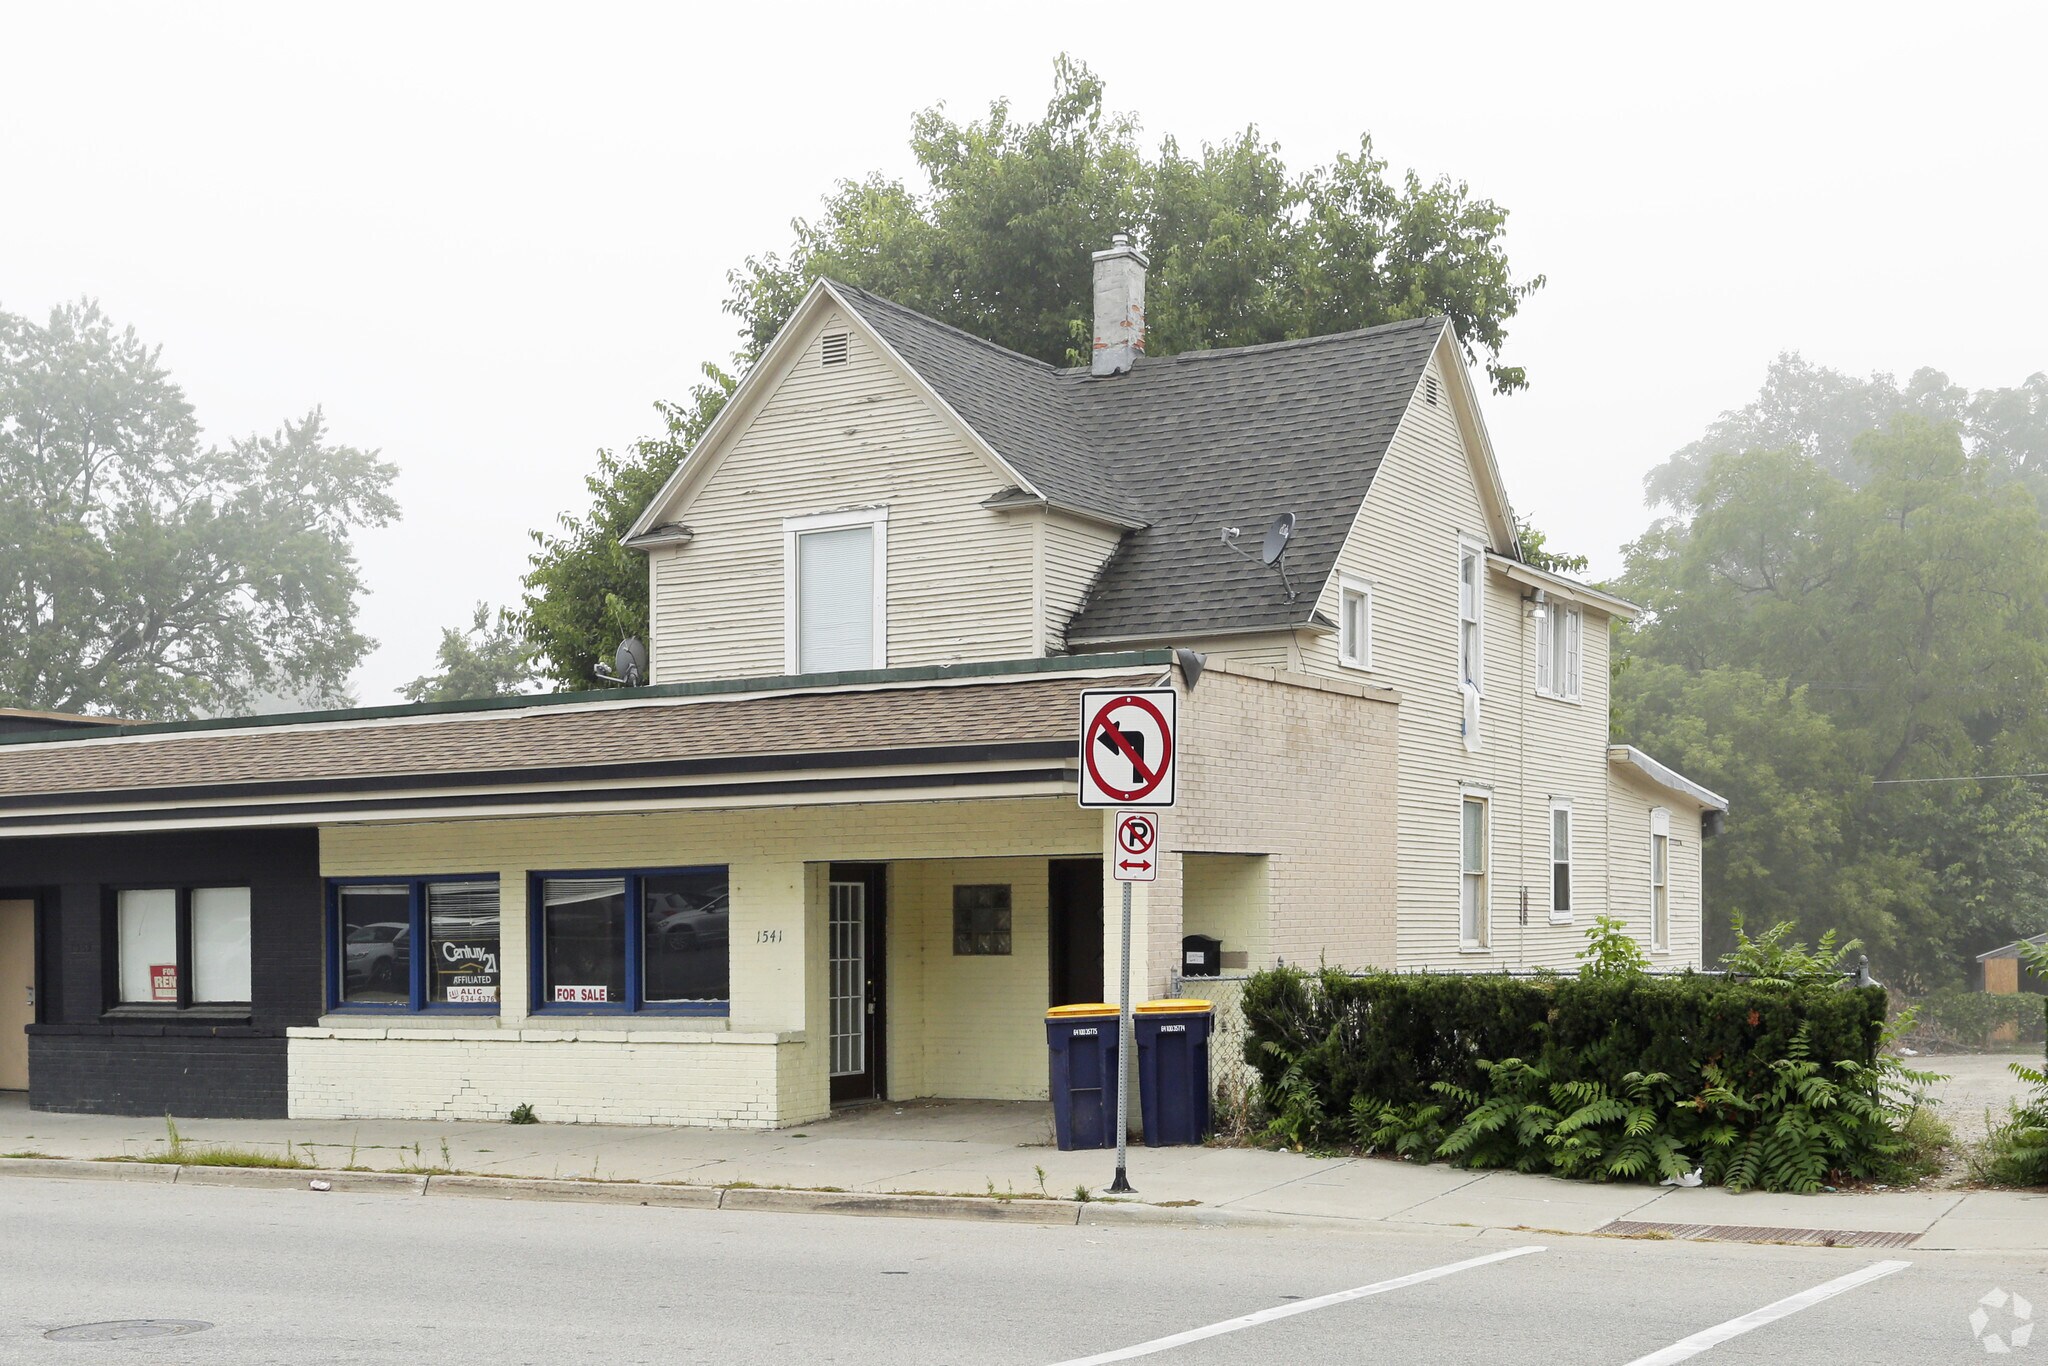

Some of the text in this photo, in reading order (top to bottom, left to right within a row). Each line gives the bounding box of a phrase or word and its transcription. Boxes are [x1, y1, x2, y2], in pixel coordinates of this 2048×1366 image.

[1129, 822, 1148, 847] P
[756, 930, 782, 944] 1541
[442, 941, 485, 962] Century
[482, 953, 498, 973] 21
[153, 975, 178, 988] REN
[453, 975, 492, 985] AFFILIATED
[557, 988, 606, 1001] FOR SALE
